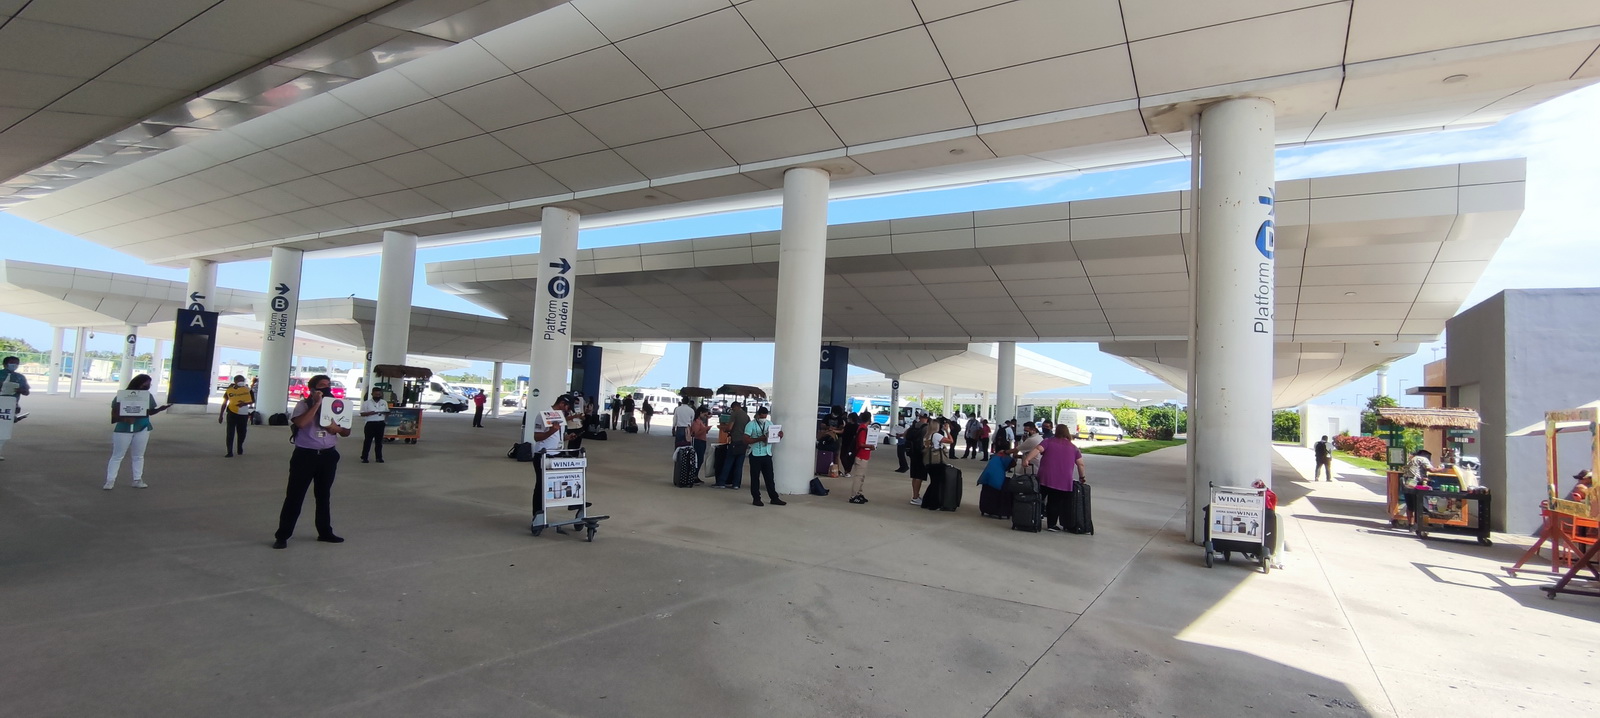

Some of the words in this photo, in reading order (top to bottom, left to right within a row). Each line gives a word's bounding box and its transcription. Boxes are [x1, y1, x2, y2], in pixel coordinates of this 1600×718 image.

[552, 279, 566, 295] C
[274, 299, 286, 309] B
[1253, 262, 1270, 334] Platform
[190, 314, 205, 328] A
[267, 312, 278, 342] Platform
[277, 313, 288, 338] Andén
[543, 300, 558, 340] Platform
[557, 301, 569, 335] Andén
[576, 348, 583, 359] B
[820, 349, 830, 362] C
